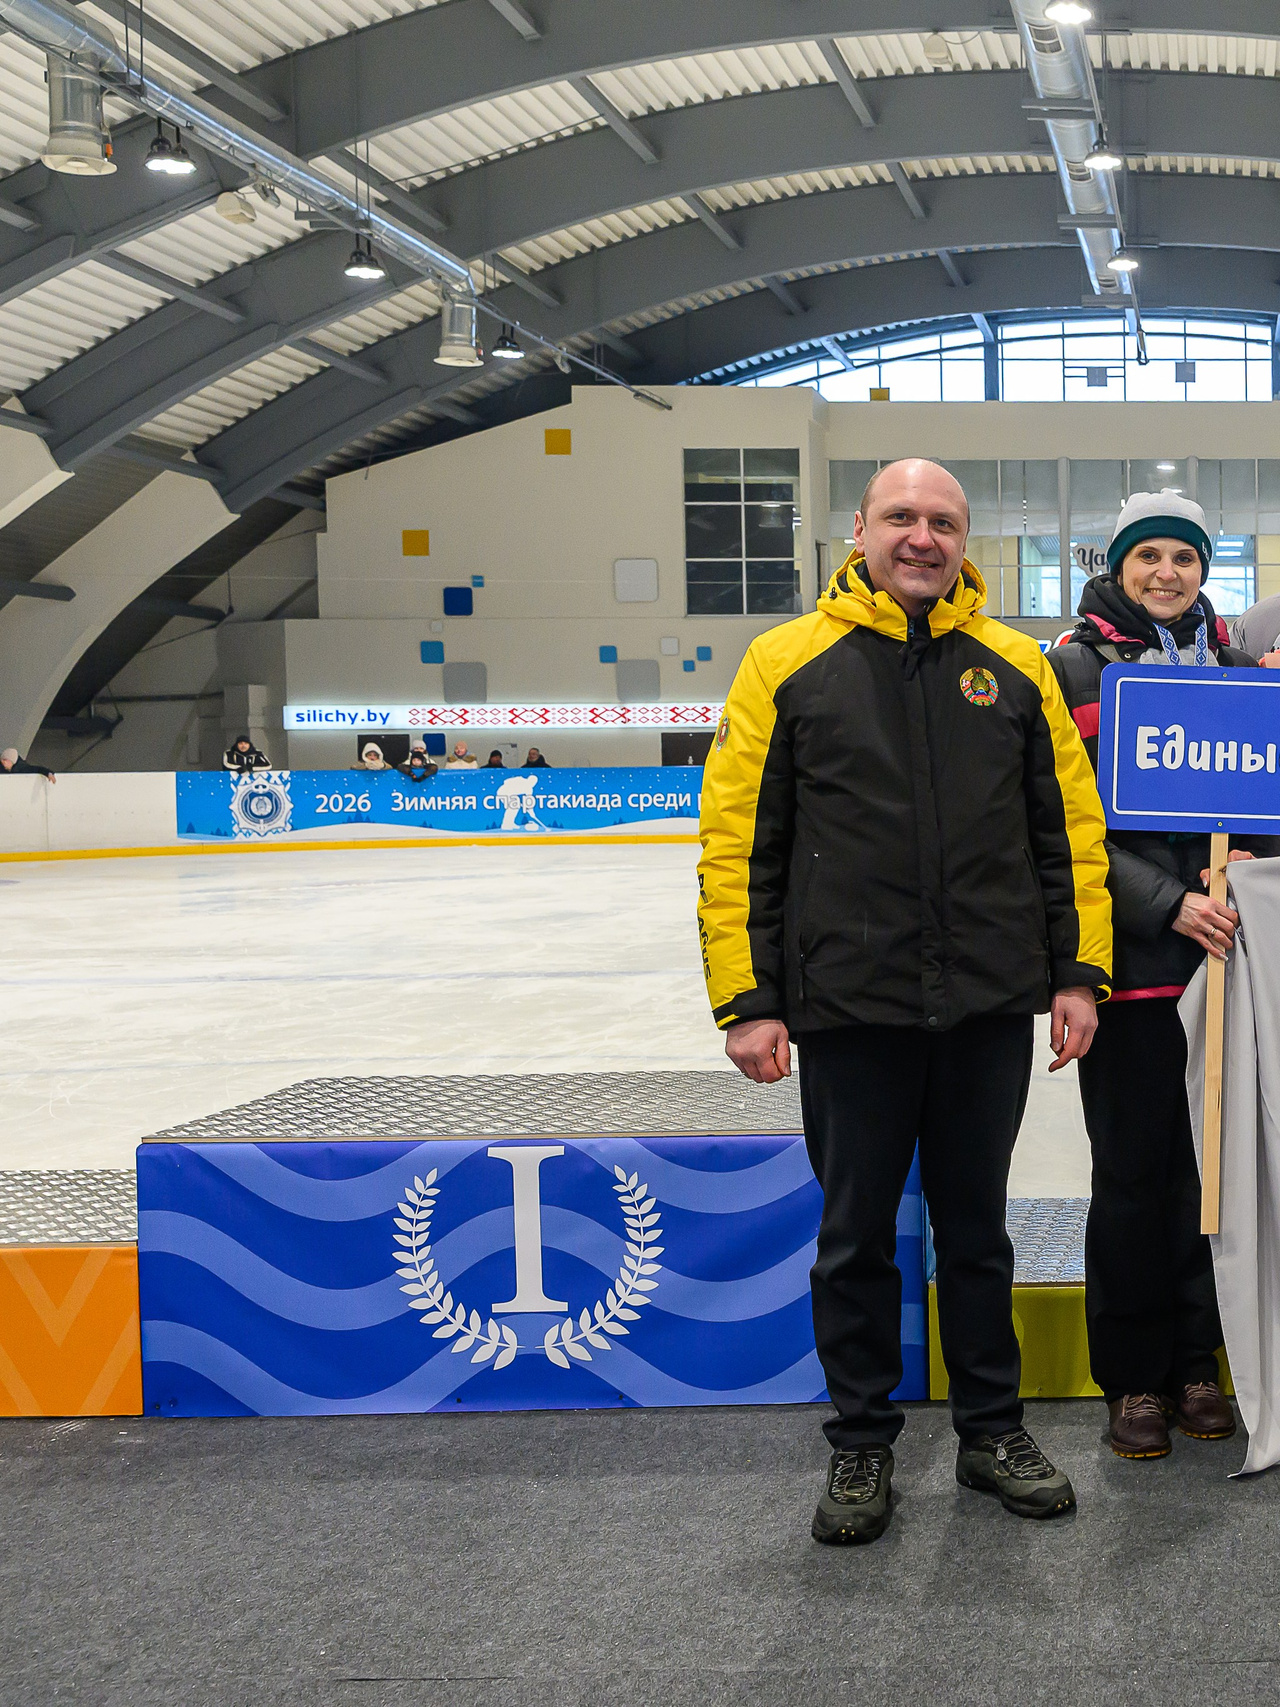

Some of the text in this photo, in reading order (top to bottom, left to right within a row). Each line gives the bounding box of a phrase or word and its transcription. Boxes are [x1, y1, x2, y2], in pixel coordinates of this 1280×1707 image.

[295, 709, 391, 725] silichy.by
[315, 794, 372, 813] 2026
[391, 793, 477, 812] Зимняя
[483, 793, 621, 818] спартакиада
[628, 792, 692, 816] среди
